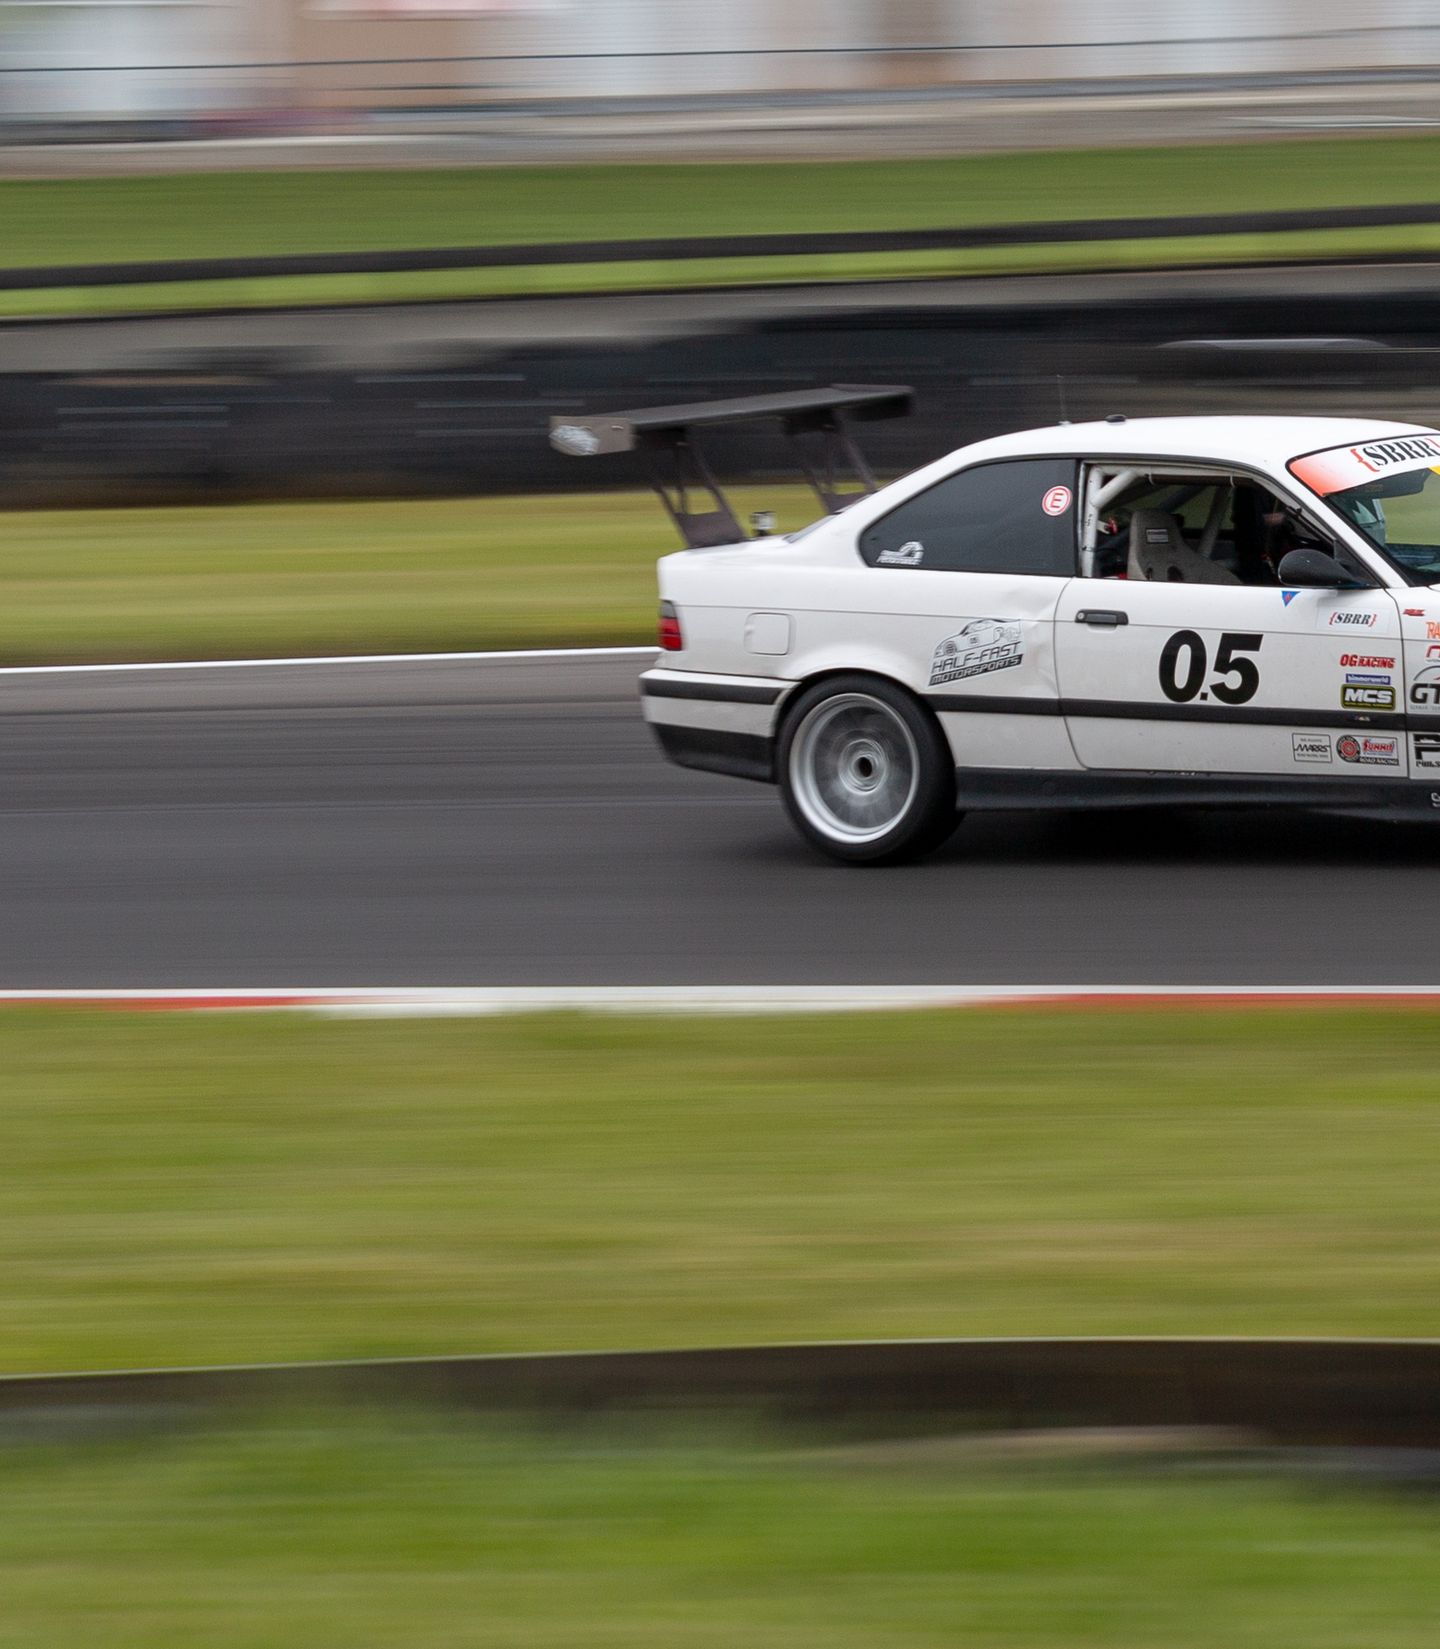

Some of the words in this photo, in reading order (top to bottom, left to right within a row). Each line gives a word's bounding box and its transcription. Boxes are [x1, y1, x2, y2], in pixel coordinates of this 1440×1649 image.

[1050, 493, 1064, 509] E
[931, 641, 1023, 674] HALF-FAST
[1159, 629, 1264, 705] 0.5
[1340, 654, 1358, 667] OG
[1358, 656, 1396, 669] RACING
[930, 655, 1020, 685] MOTORSPORTS
[1344, 688, 1393, 704] MCS
